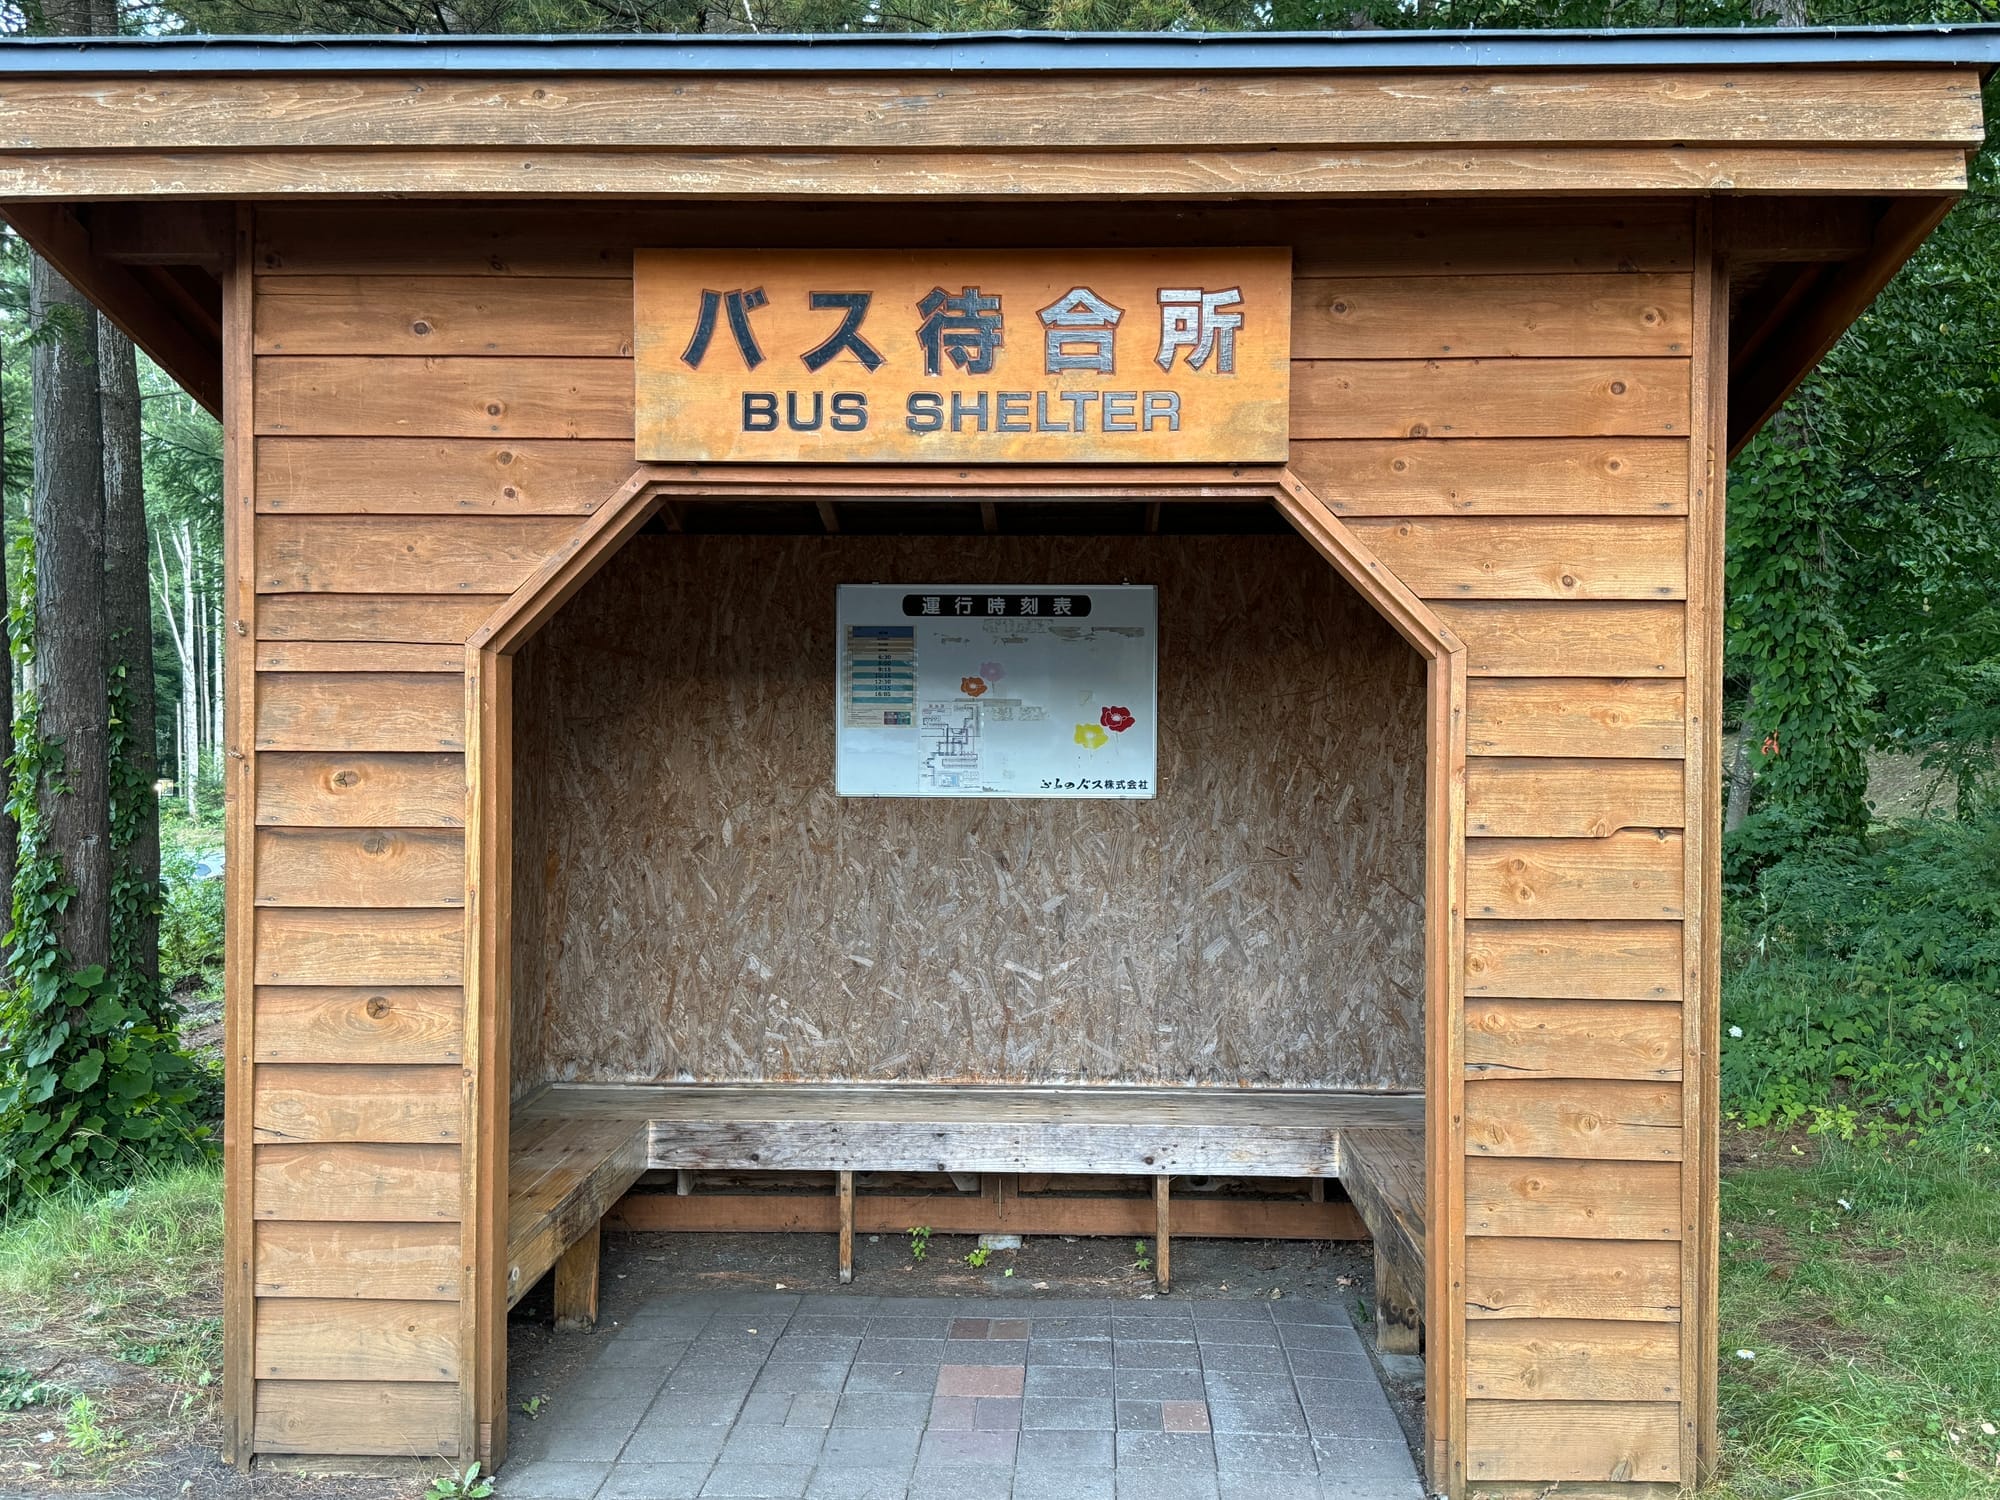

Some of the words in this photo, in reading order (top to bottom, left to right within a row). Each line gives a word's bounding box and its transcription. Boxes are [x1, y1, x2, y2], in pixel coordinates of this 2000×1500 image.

[680, 285, 1245, 376] バス待合所
[742, 391, 869, 433] BUS
[904, 391, 1182, 433] SHELTER
[921, 597, 1072, 615] 運行時刻表
